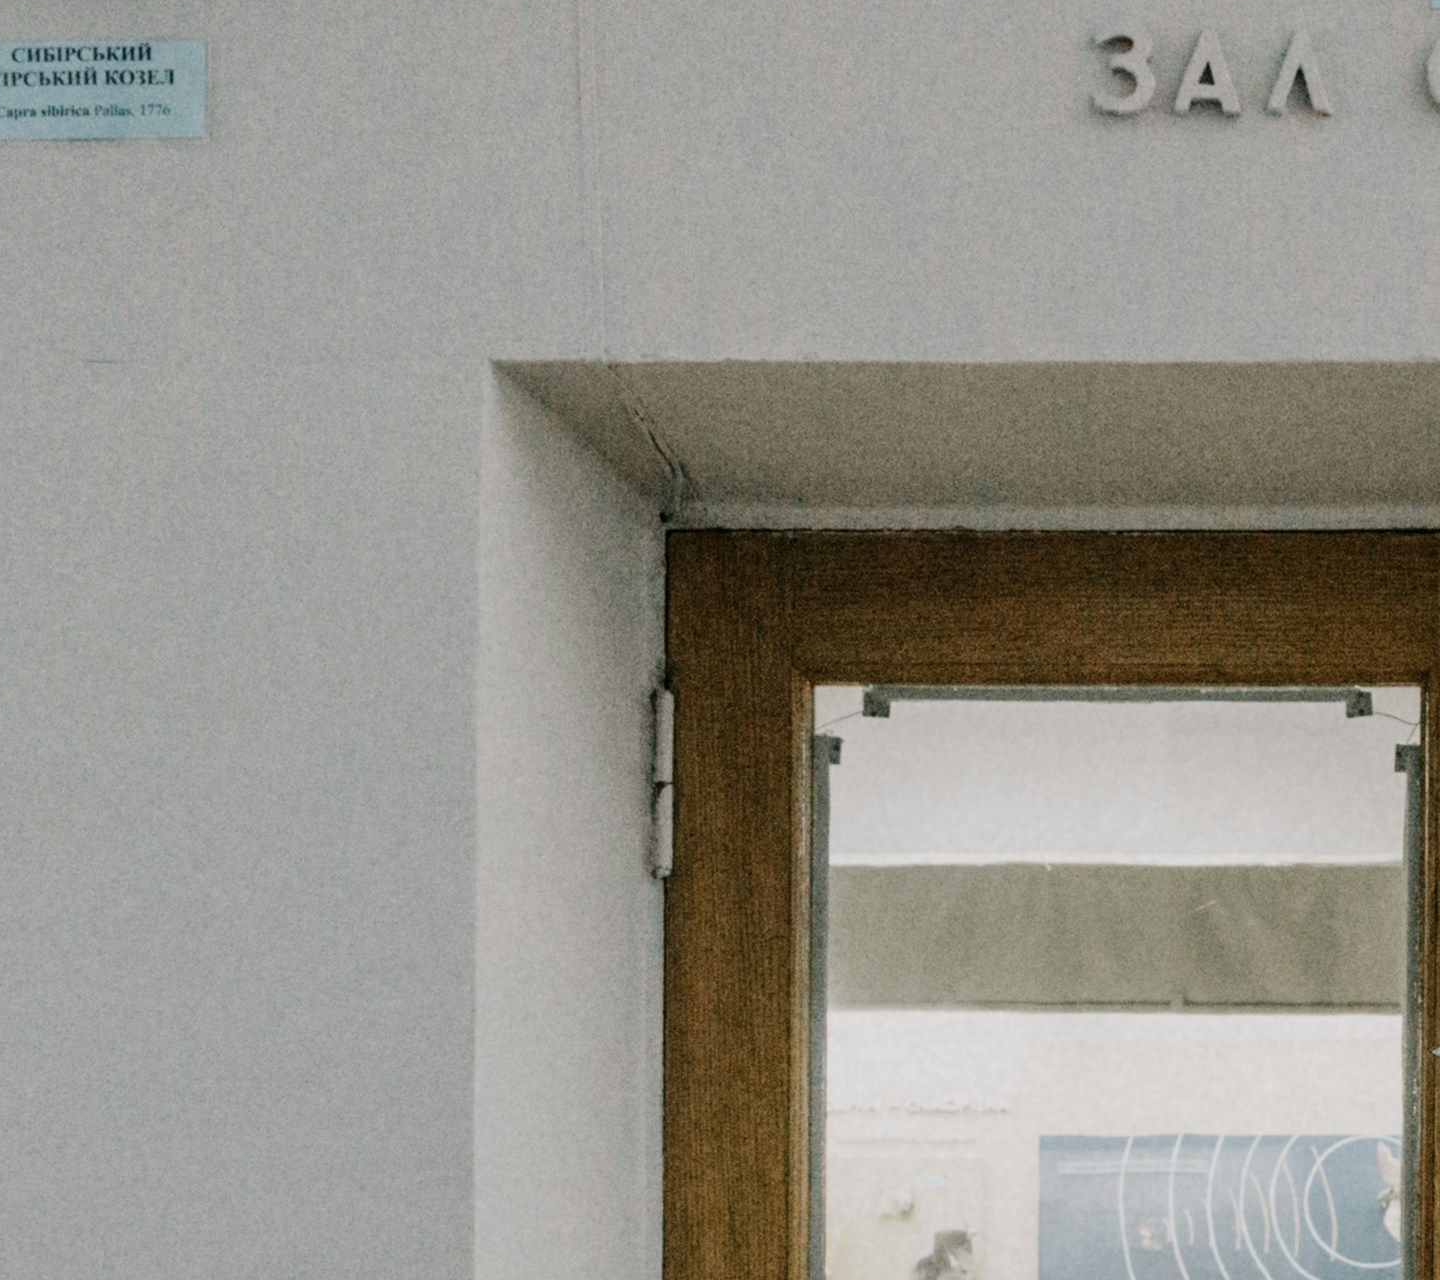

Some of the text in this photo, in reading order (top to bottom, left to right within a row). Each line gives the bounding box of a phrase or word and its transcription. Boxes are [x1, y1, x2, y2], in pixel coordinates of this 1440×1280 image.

[11, 43, 153, 63] СИБІРСЬКИЙ
[105, 69, 176, 86] КОЗЕЛ
[1090, 28, 1333, 118] ЗАЛ
[41, 104, 90, 117] sibirica
[140, 104, 171, 117] 1776
